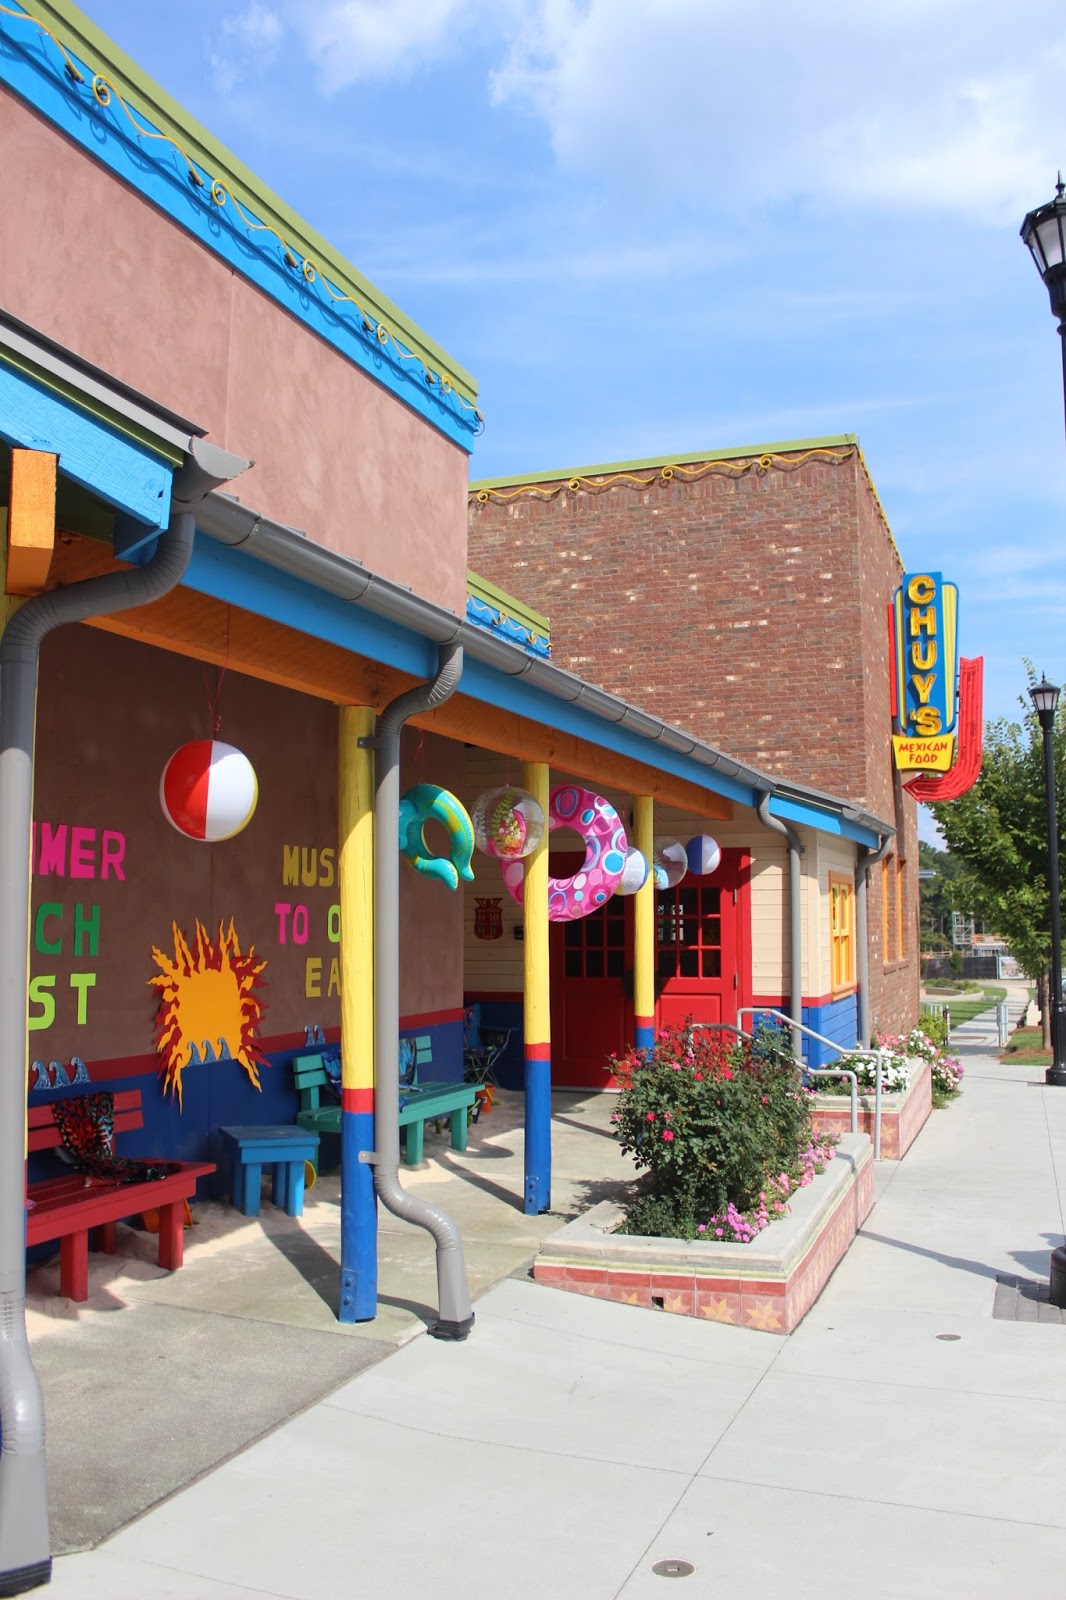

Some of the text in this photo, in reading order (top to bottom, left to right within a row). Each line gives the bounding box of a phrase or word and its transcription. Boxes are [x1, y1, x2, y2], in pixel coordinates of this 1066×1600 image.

[907, 574, 942, 737] CHUY'S
[898, 741, 949, 754] MEXICAN
[909, 753, 938, 764] FOOD
[31, 821, 126, 881] MER
[282, 844, 340, 888] MUS
[274, 903, 309, 945] TO
